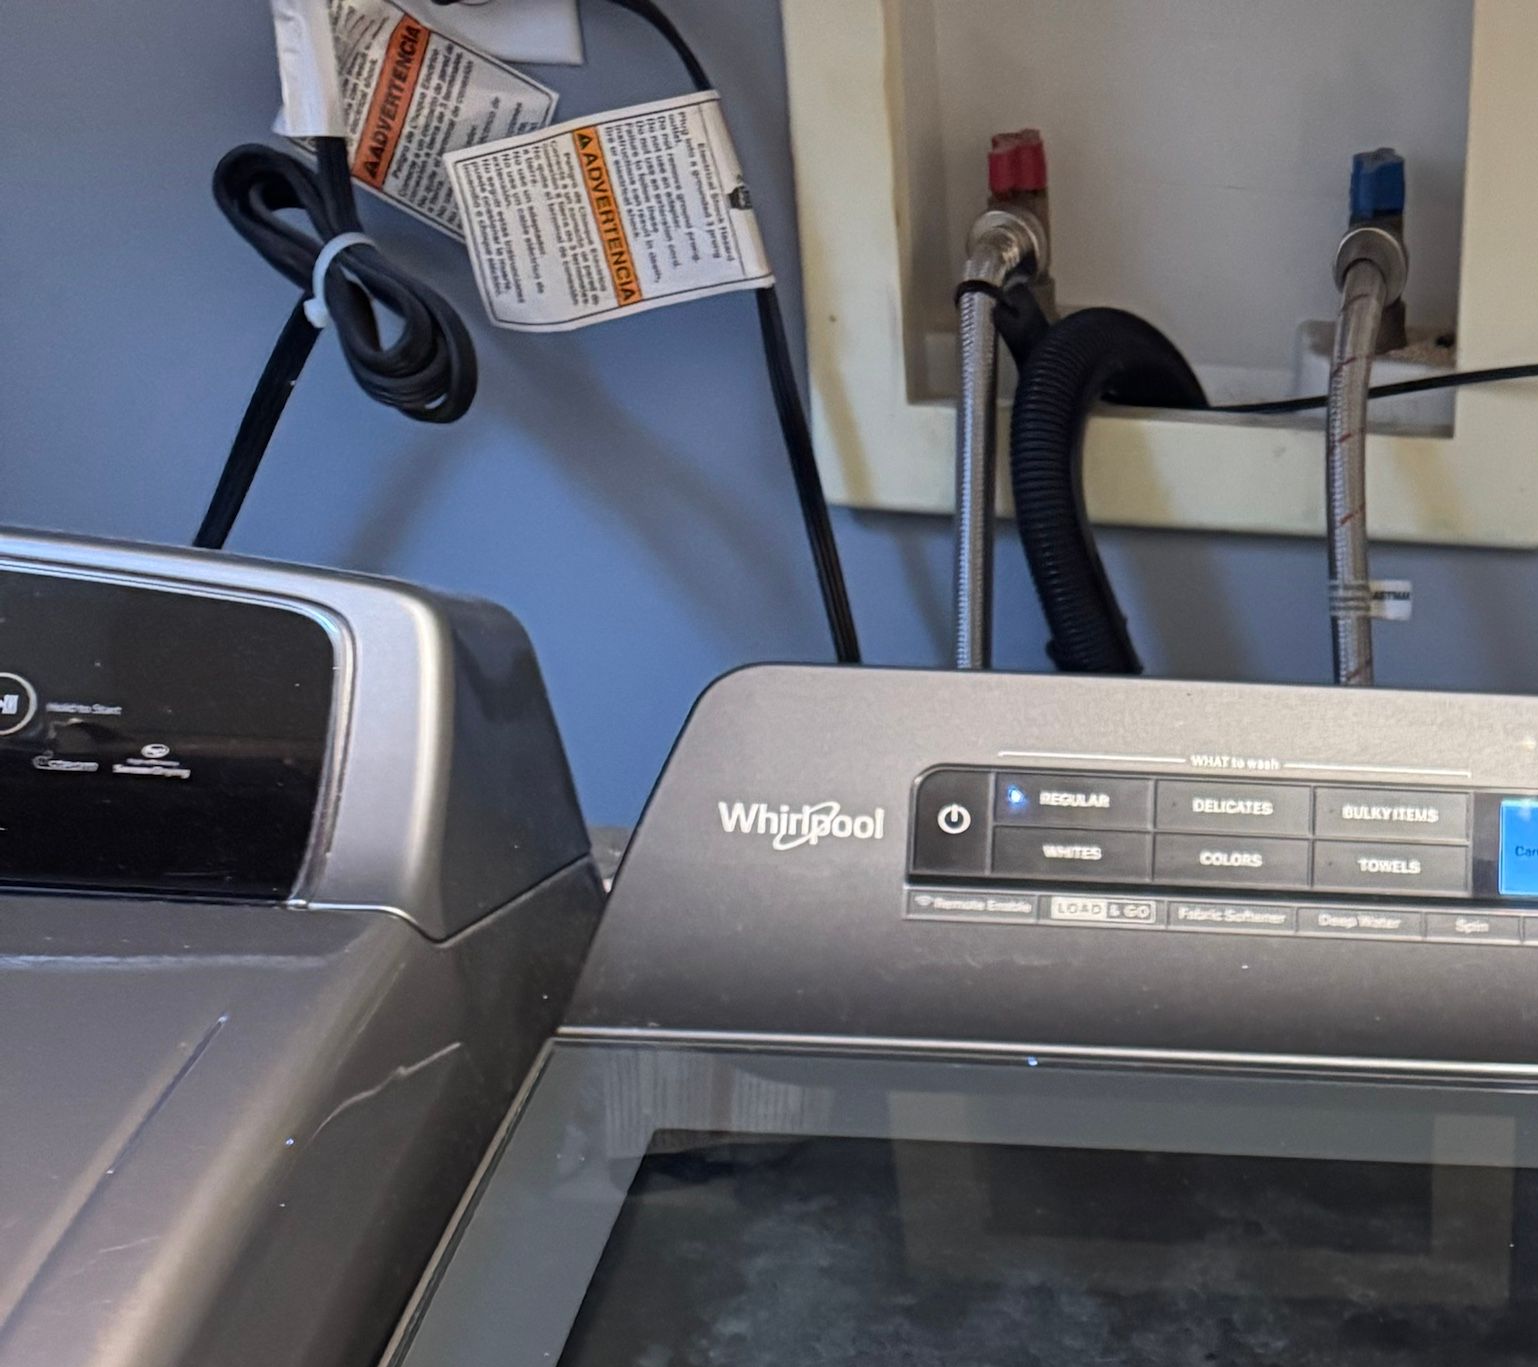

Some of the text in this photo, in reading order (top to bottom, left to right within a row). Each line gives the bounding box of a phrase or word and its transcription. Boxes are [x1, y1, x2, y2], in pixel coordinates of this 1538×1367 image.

[366, 24, 421, 159] ADVERTENCIA
[583, 149, 636, 302] ADVERTENCIA
[1190, 754, 1280, 770] WHAT to wash
[1039, 790, 1110, 808] REGULAR
[1192, 797, 1274, 816] DELICATES
[1342, 804, 1439, 823] BULKY ITEMS
[718, 800, 885, 850] Whirlpool
[1042, 844, 1102, 860] WHITES
[1199, 851, 1263, 868] COLORS
[1357, 857, 1421, 875] TOWELS
[1057, 902, 1101, 915] LOAD
[1122, 904, 1150, 918] GO
[1178, 907, 1287, 924] Fabric Softener
[1318, 914, 1401, 930] Deep Water
[1455, 918, 1489, 935] Spin
